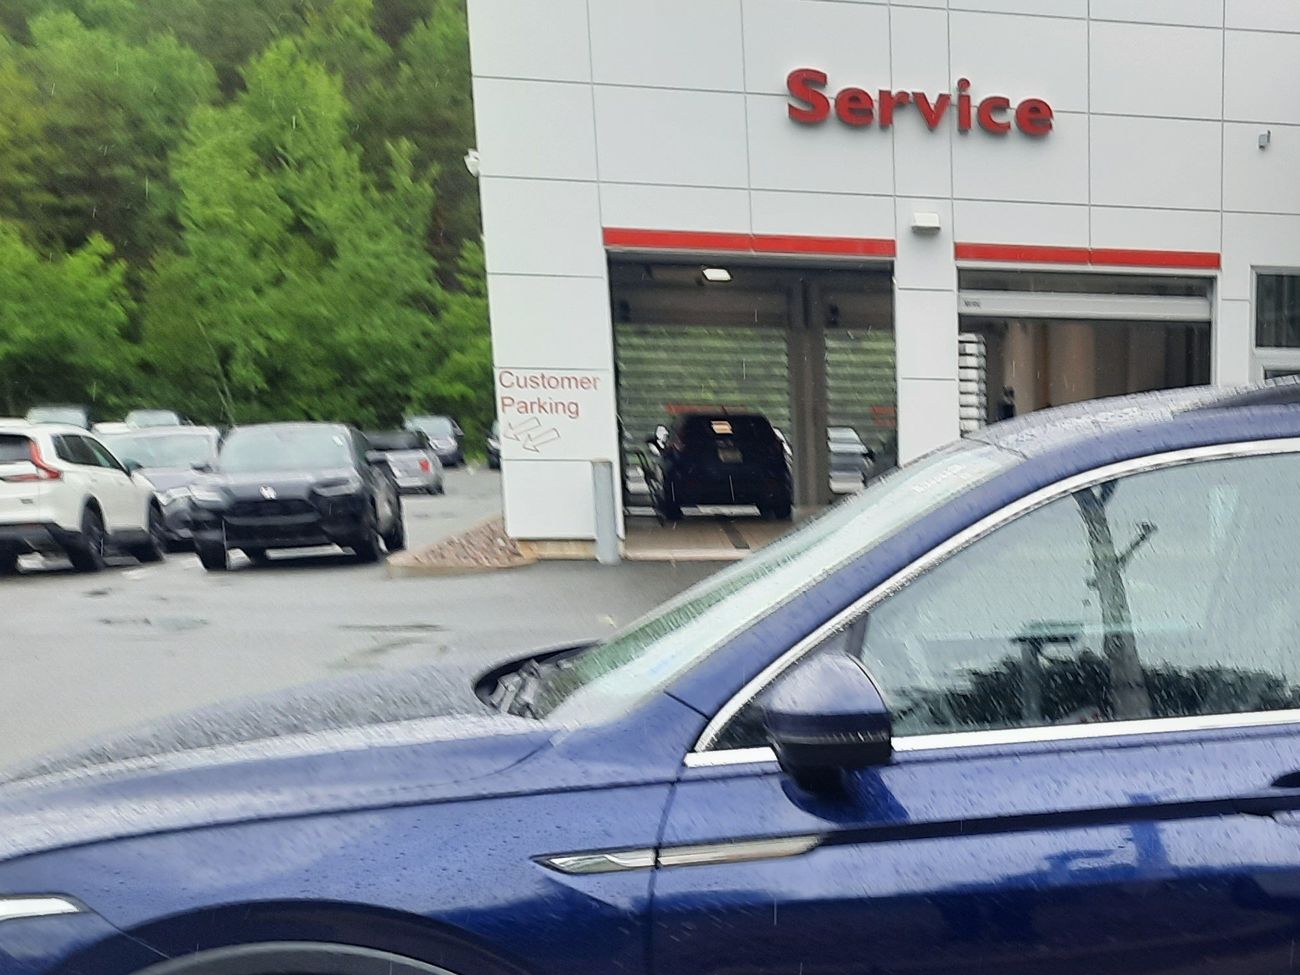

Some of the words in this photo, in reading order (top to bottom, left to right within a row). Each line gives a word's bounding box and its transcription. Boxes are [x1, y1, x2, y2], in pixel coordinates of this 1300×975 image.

[787, 68, 1054, 135] Service
[499, 370, 600, 390] Customer
[500, 396, 580, 419] Parking
